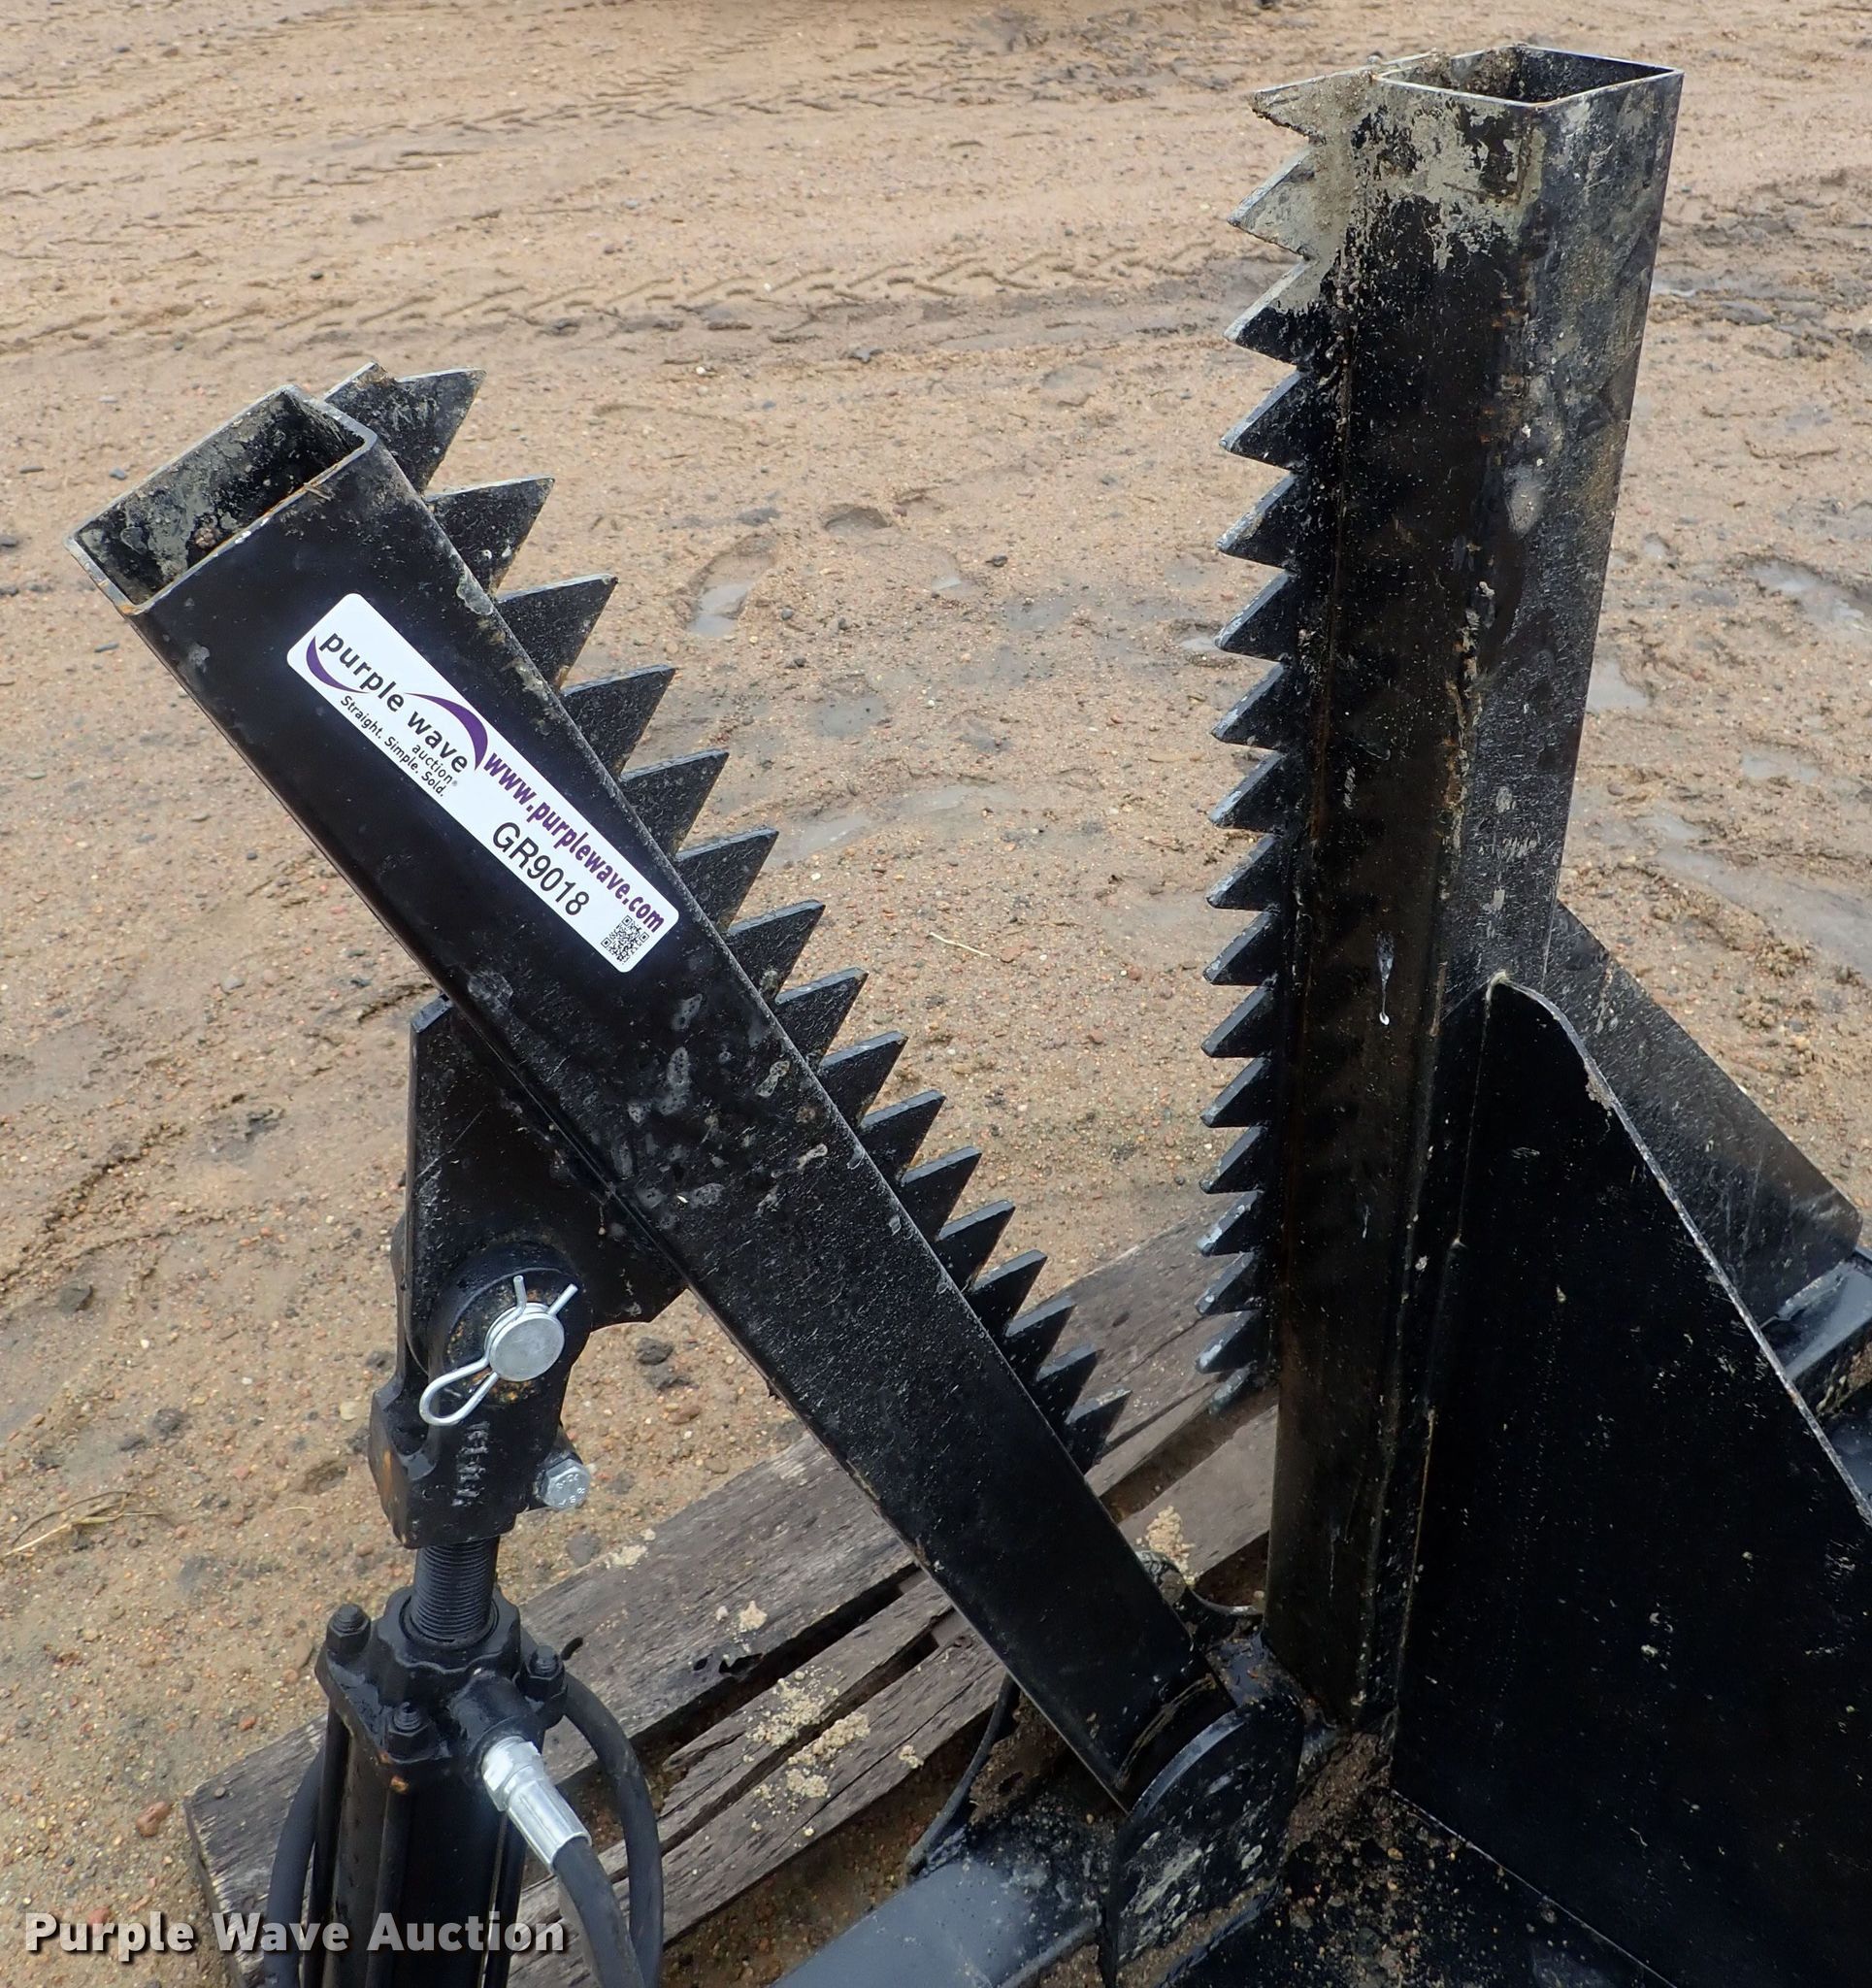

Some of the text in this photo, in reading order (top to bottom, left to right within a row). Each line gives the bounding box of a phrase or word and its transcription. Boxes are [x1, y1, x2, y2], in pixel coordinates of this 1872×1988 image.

[319, 633, 468, 774] purple wave
[340, 695, 446, 797] Straight. Simple. Sold.
[483, 752, 665, 933] www.purplewave.com
[492, 822, 590, 915] GR9018
